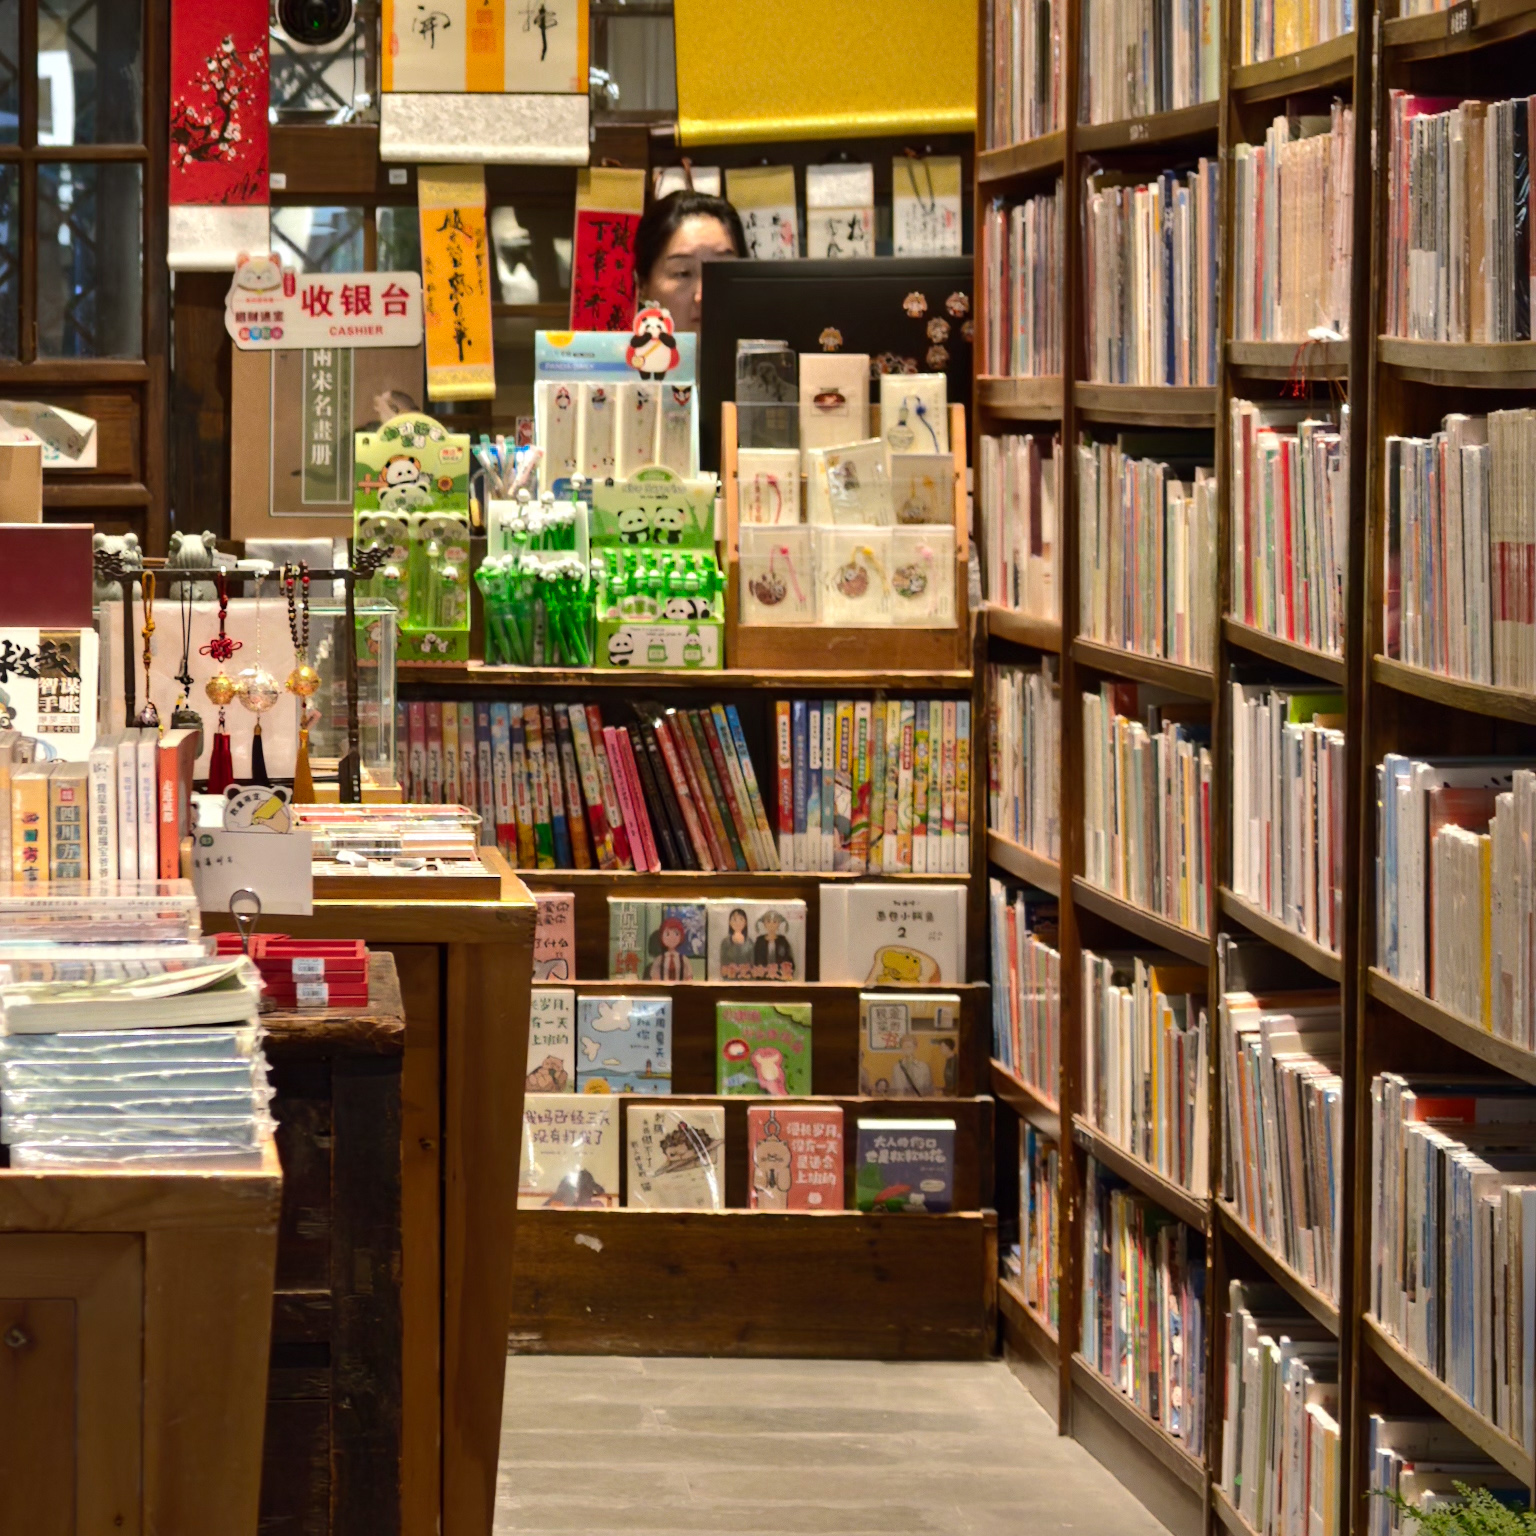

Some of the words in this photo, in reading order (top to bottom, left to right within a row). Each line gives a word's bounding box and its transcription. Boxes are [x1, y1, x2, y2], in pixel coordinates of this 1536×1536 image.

[301, 282, 410, 318] 收银台
[329, 325, 384, 336] CASHIER
[38, 677, 80, 695] 智谋
[38, 695, 80, 713] 手账
[897, 926, 907, 939] 2
[531, 1034, 569, 1046] 上班的
[525, 1109, 611, 1126] 我妈已经三天
[532, 1129, 604, 1146] 没有打我了
[791, 1139, 839, 1154] 没有一天
[795, 1171, 837, 1186] 上班的
